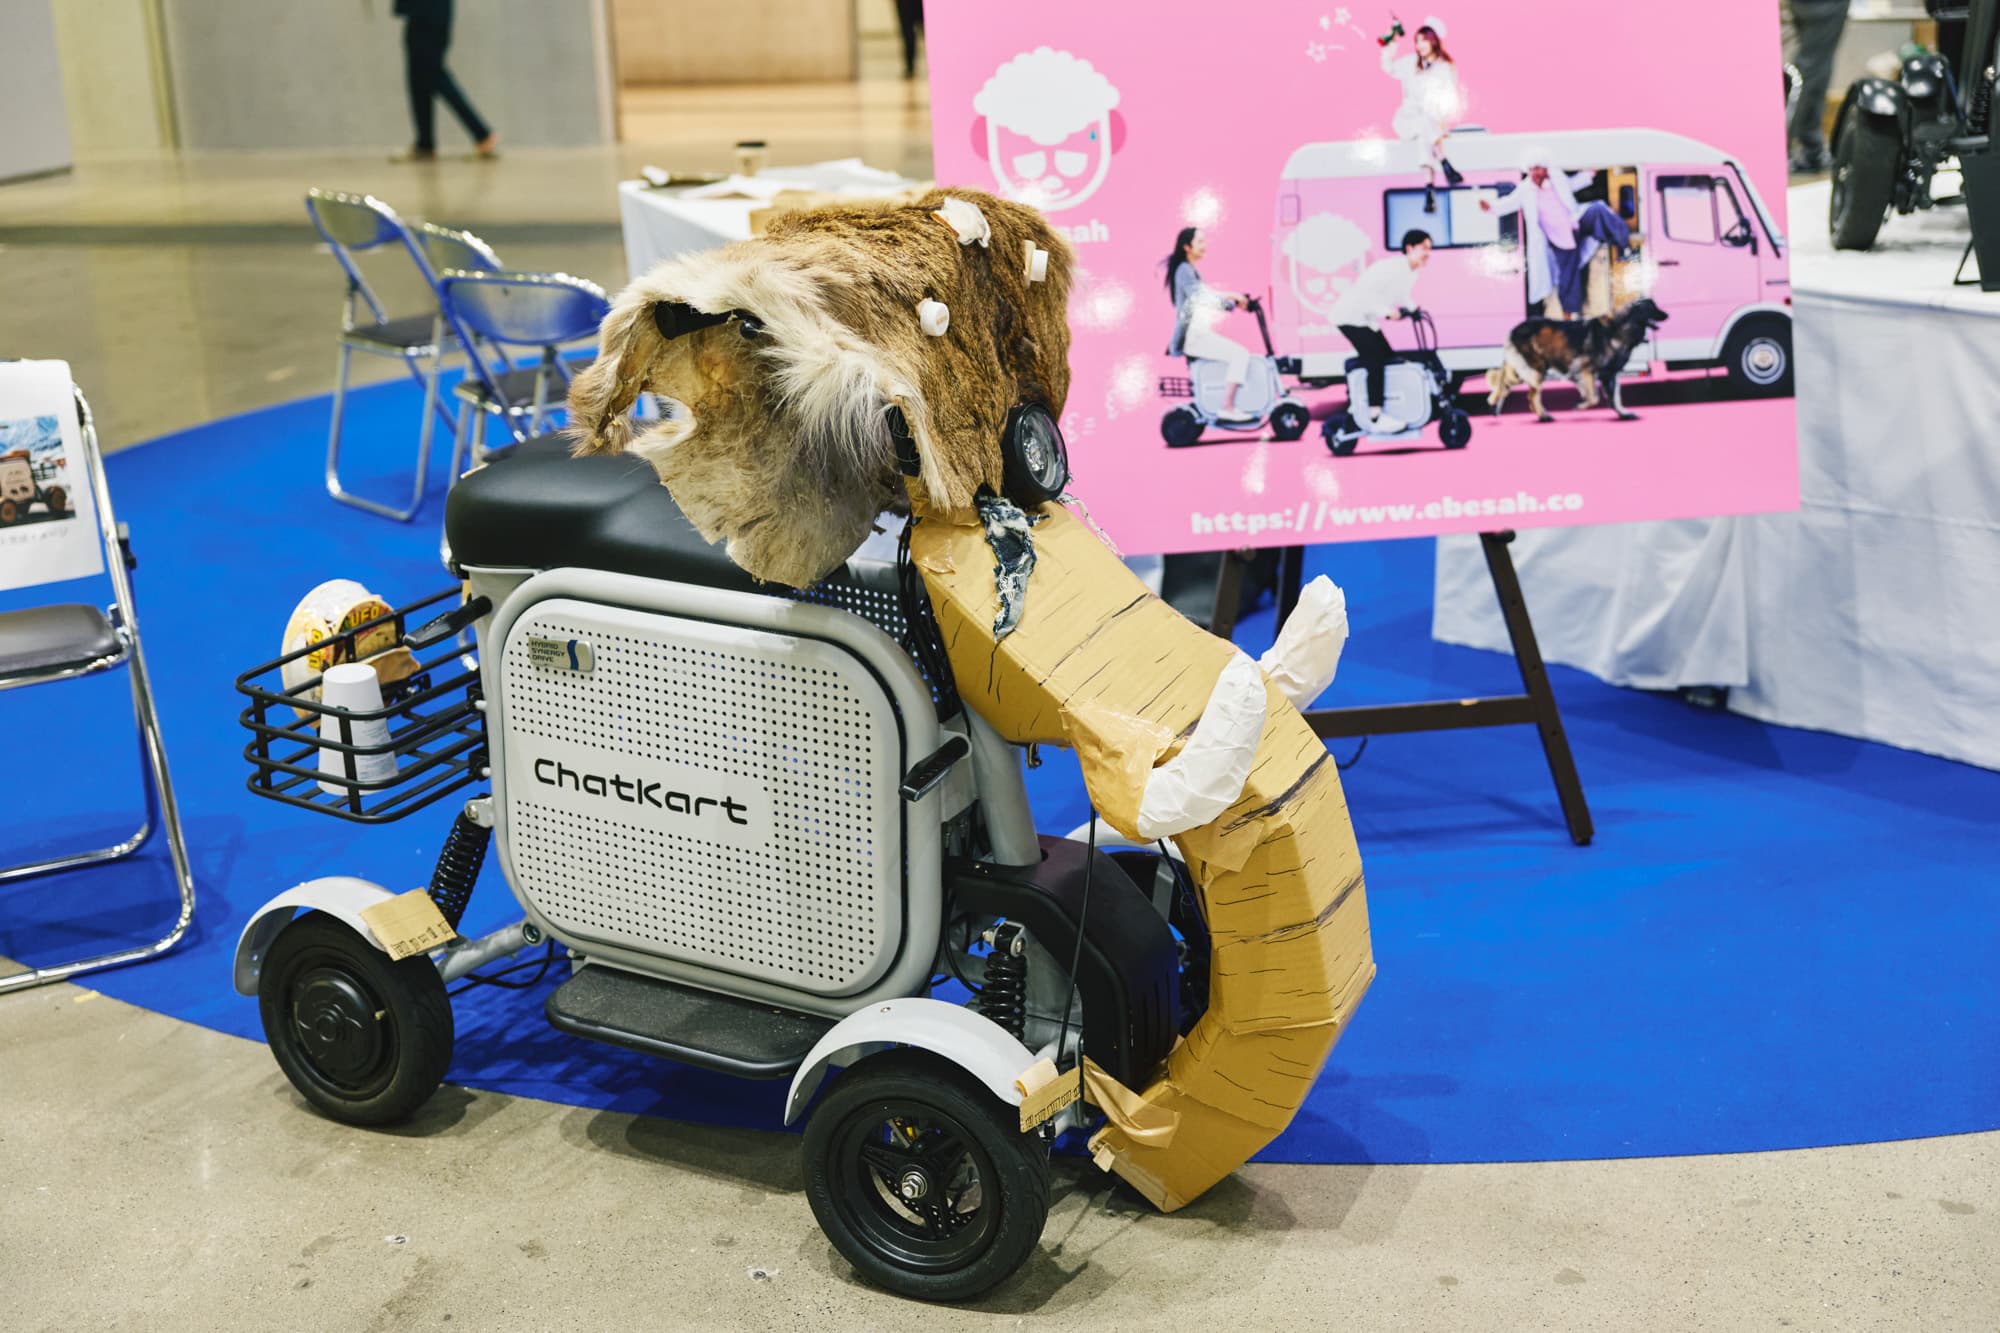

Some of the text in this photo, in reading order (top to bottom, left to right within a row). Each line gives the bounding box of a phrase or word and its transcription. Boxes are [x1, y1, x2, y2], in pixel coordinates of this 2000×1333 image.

[1191, 491, 1584, 535] https://www.ebesah.co
[350, 606, 379, 627] UFO
[531, 640, 559, 650] HYBRID
[531, 646, 566, 658] SYNERGY
[532, 654, 554, 663] DRIVE
[534, 757, 748, 826] ChatKart
